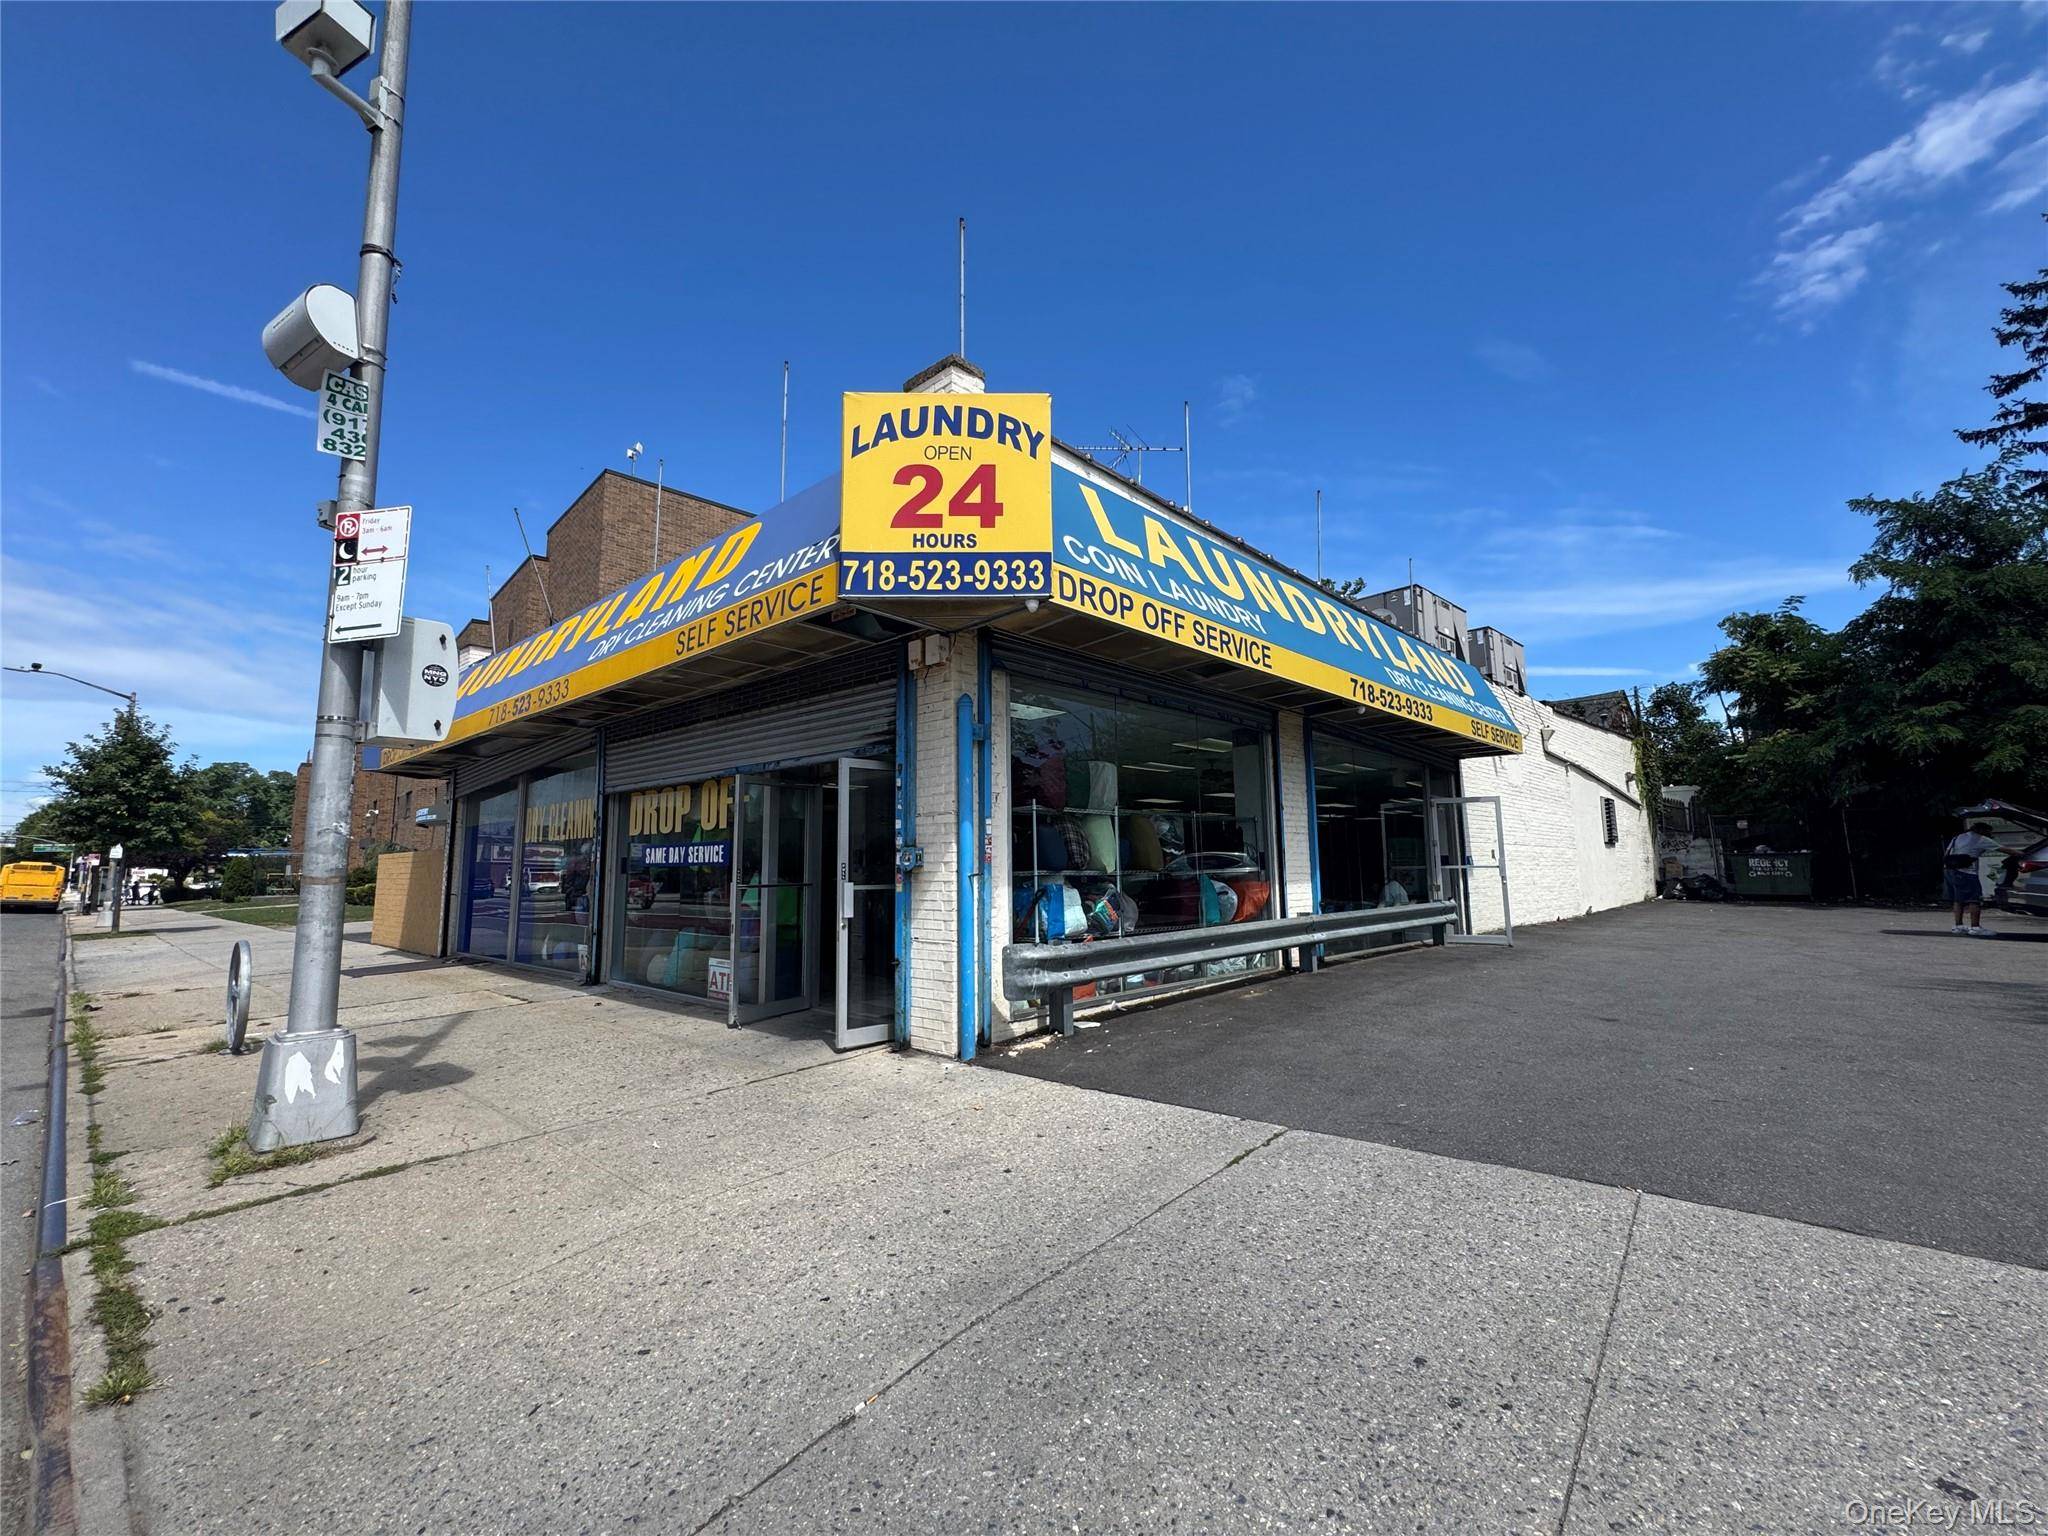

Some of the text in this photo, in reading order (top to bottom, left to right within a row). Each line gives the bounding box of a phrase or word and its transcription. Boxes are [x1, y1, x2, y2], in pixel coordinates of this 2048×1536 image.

[327, 393, 337, 406] 4
[323, 438, 366, 457] 832
[851, 405, 1045, 460] LAUNDRY
[924, 446, 972, 461] OPEN
[890, 464, 1004, 529] 24
[362, 517, 380, 525] Friday
[912, 533, 977, 549] HOURS
[336, 594, 350, 602] 9am
[357, 592, 369, 602] 7pm
[338, 567, 349, 585] 2
[352, 574, 377, 583] parking
[588, 534, 840, 661] DRY CLEANING CENTER
[843, 560, 1045, 591] 718-523-9333
[1063, 535, 1268, 635] COIN LAUNDRY
[1078, 482, 1475, 697] LAUNDRYLAND
[336, 600, 382, 612] Except Sunday
[456, 522, 763, 700] AUNDRYLAND
[676, 574, 824, 656] SELF SERVICE
[1058, 570, 1273, 669] DROP OFF SERVICE
[488, 678, 570, 726] 718-523-9333
[1350, 677, 1433, 722] 718-523-9333
[1383, 666, 1511, 726] DRY CLEANING CENTER
[1470, 719, 1518, 750] SELF SERVICE
[525, 798, 594, 843] DRY CLEANIN
[629, 785, 692, 836] DROP
[645, 845, 724, 864] SAME DAY SERVICE
